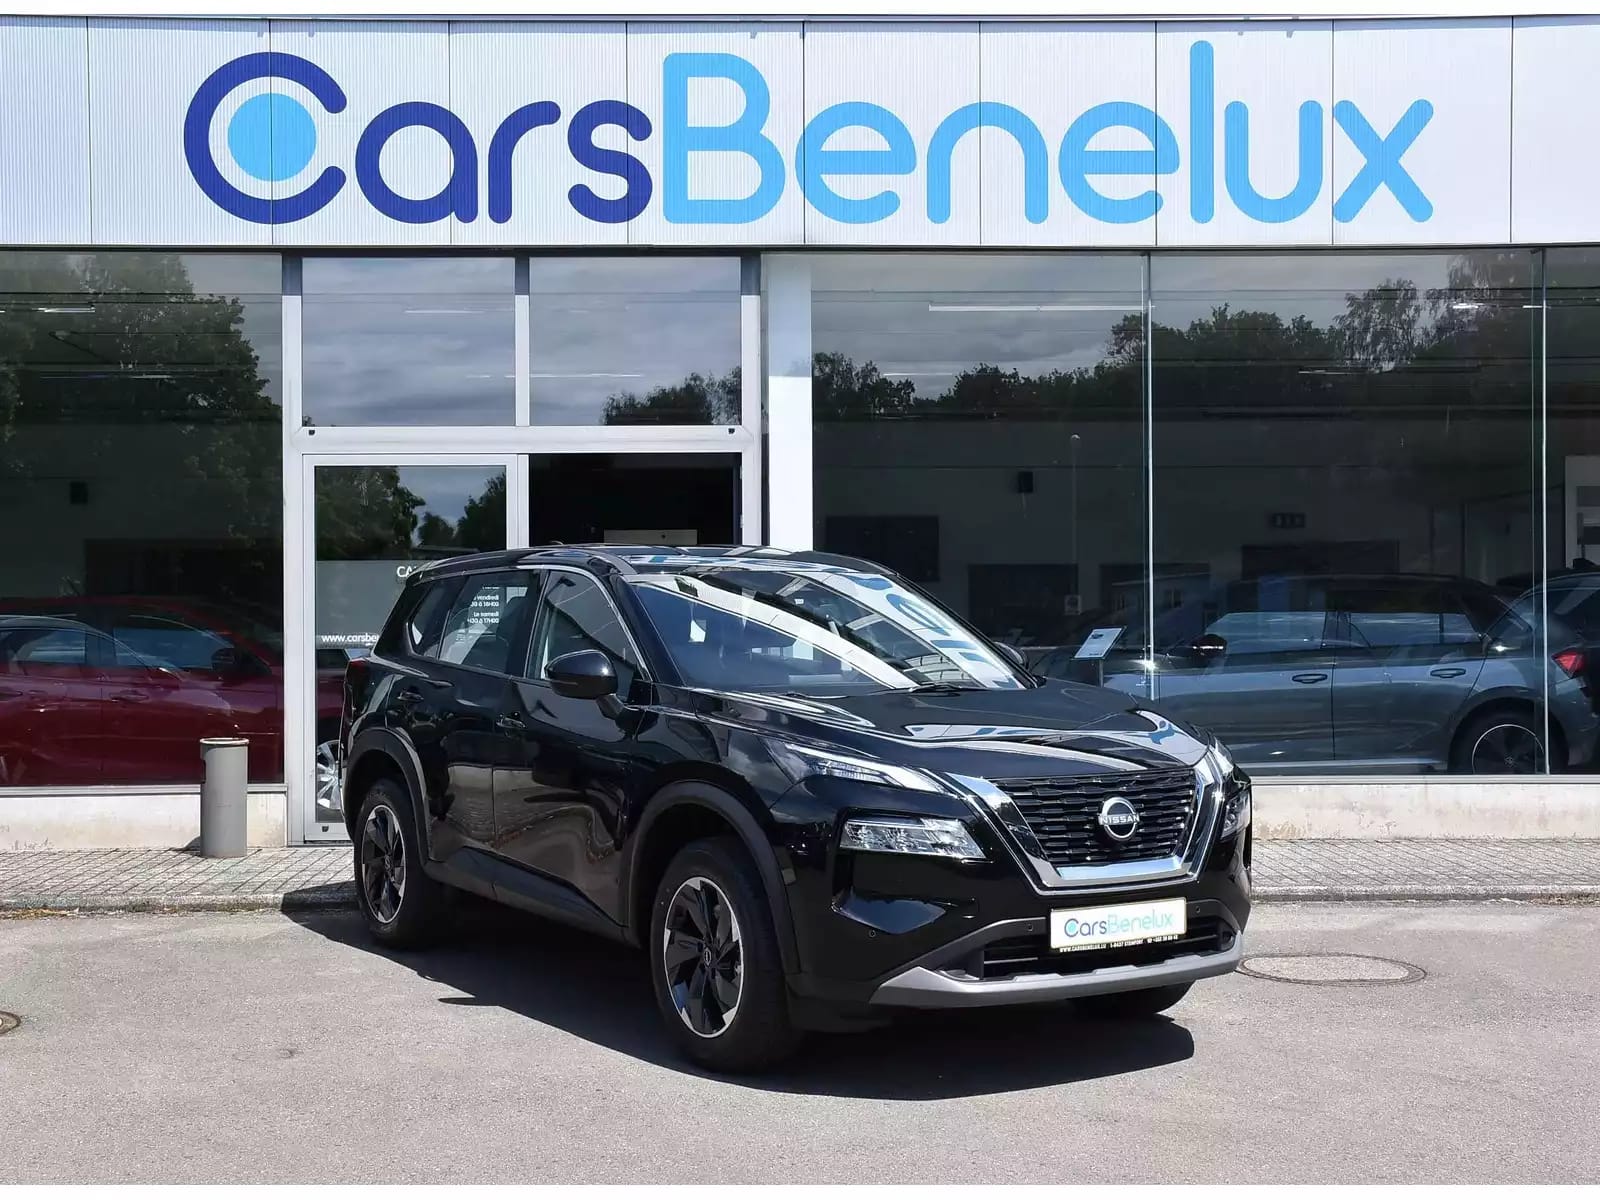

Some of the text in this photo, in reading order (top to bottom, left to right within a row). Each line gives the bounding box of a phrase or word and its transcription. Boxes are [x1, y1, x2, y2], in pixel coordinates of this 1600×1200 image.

[184, 40, 1434, 225] CarsBenelux
[1102, 812, 1140, 825] NISSAN
[1064, 909, 1173, 938] CarsBenelux
